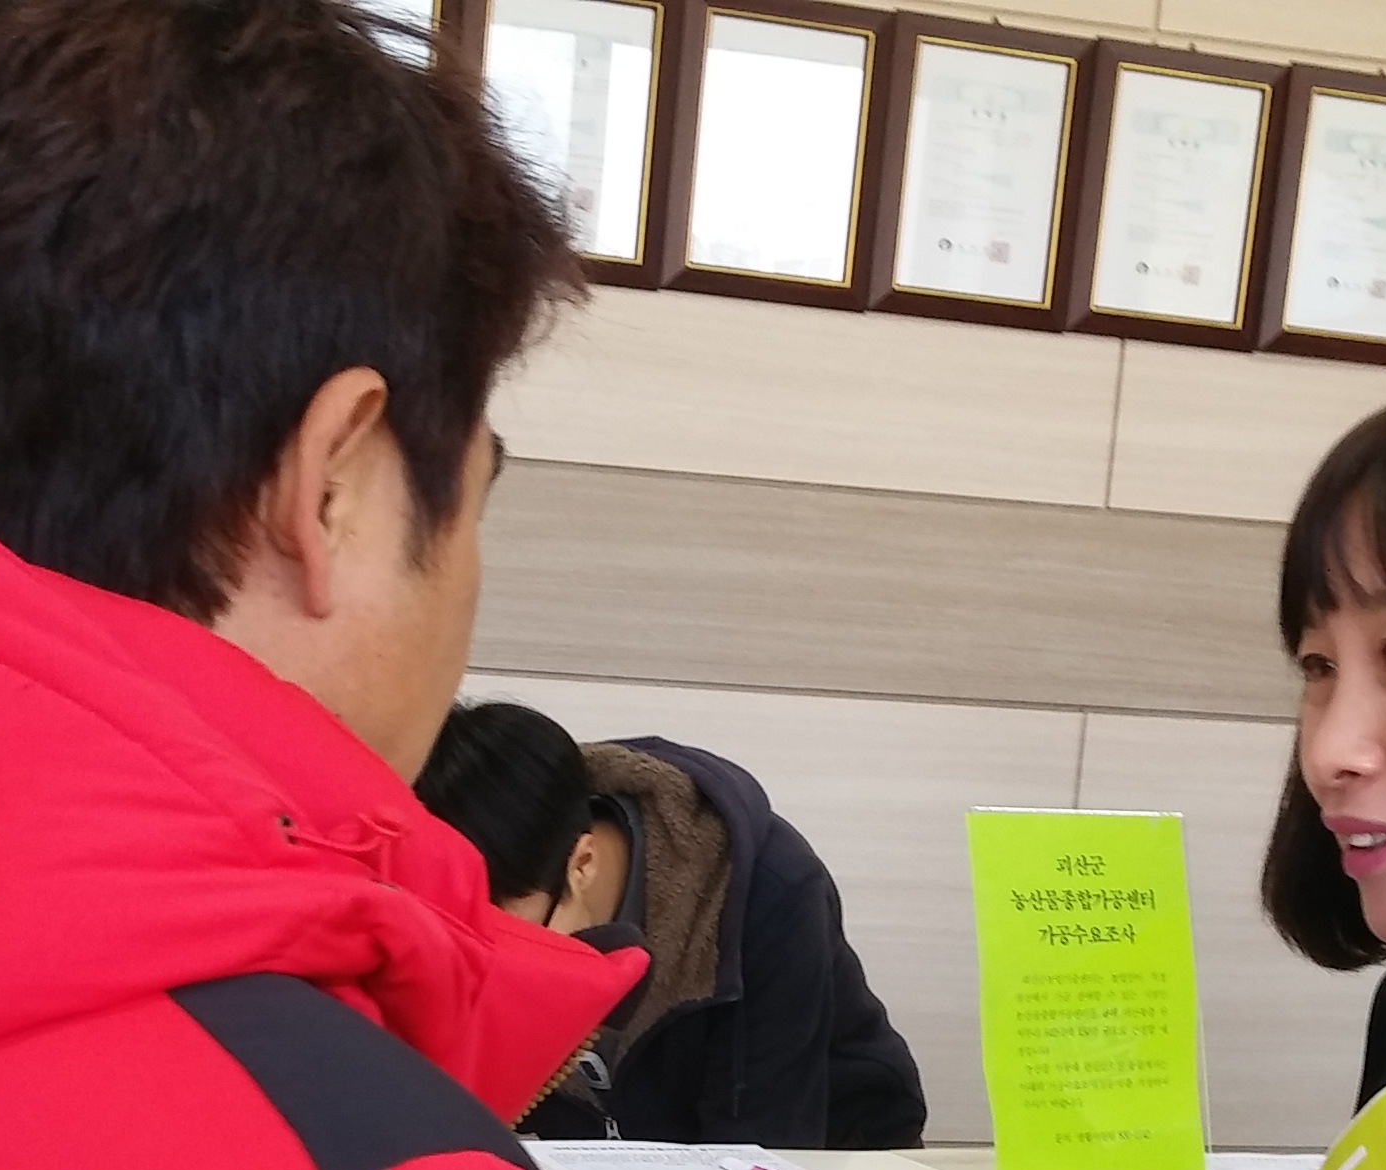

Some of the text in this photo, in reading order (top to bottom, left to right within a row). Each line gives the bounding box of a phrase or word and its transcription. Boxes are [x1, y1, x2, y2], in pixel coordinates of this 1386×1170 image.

[1055, 854, 1106, 876] 괴산군
[1010, 889, 1156, 911] 농산물종합가공센터
[1038, 923, 1136, 946] 가공수요조사
